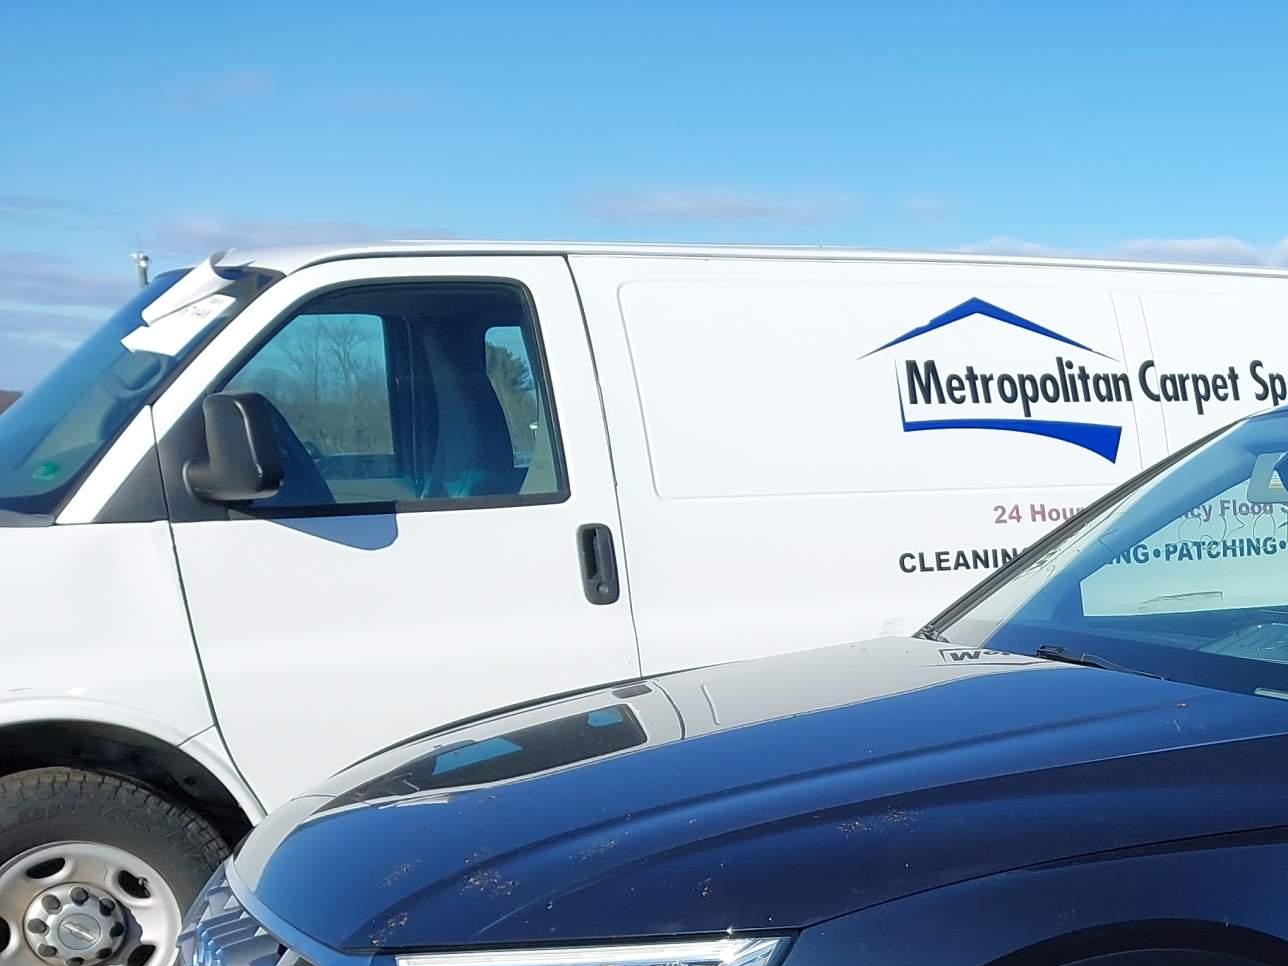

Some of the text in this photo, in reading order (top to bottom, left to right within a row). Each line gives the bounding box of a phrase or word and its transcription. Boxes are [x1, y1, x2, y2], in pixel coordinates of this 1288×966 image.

[905, 356, 1133, 417] Metropolitan
[1138, 359, 1241, 415] Carpet
[993, 504, 1022, 524] 24
[899, 546, 1030, 573] CLEANIN
